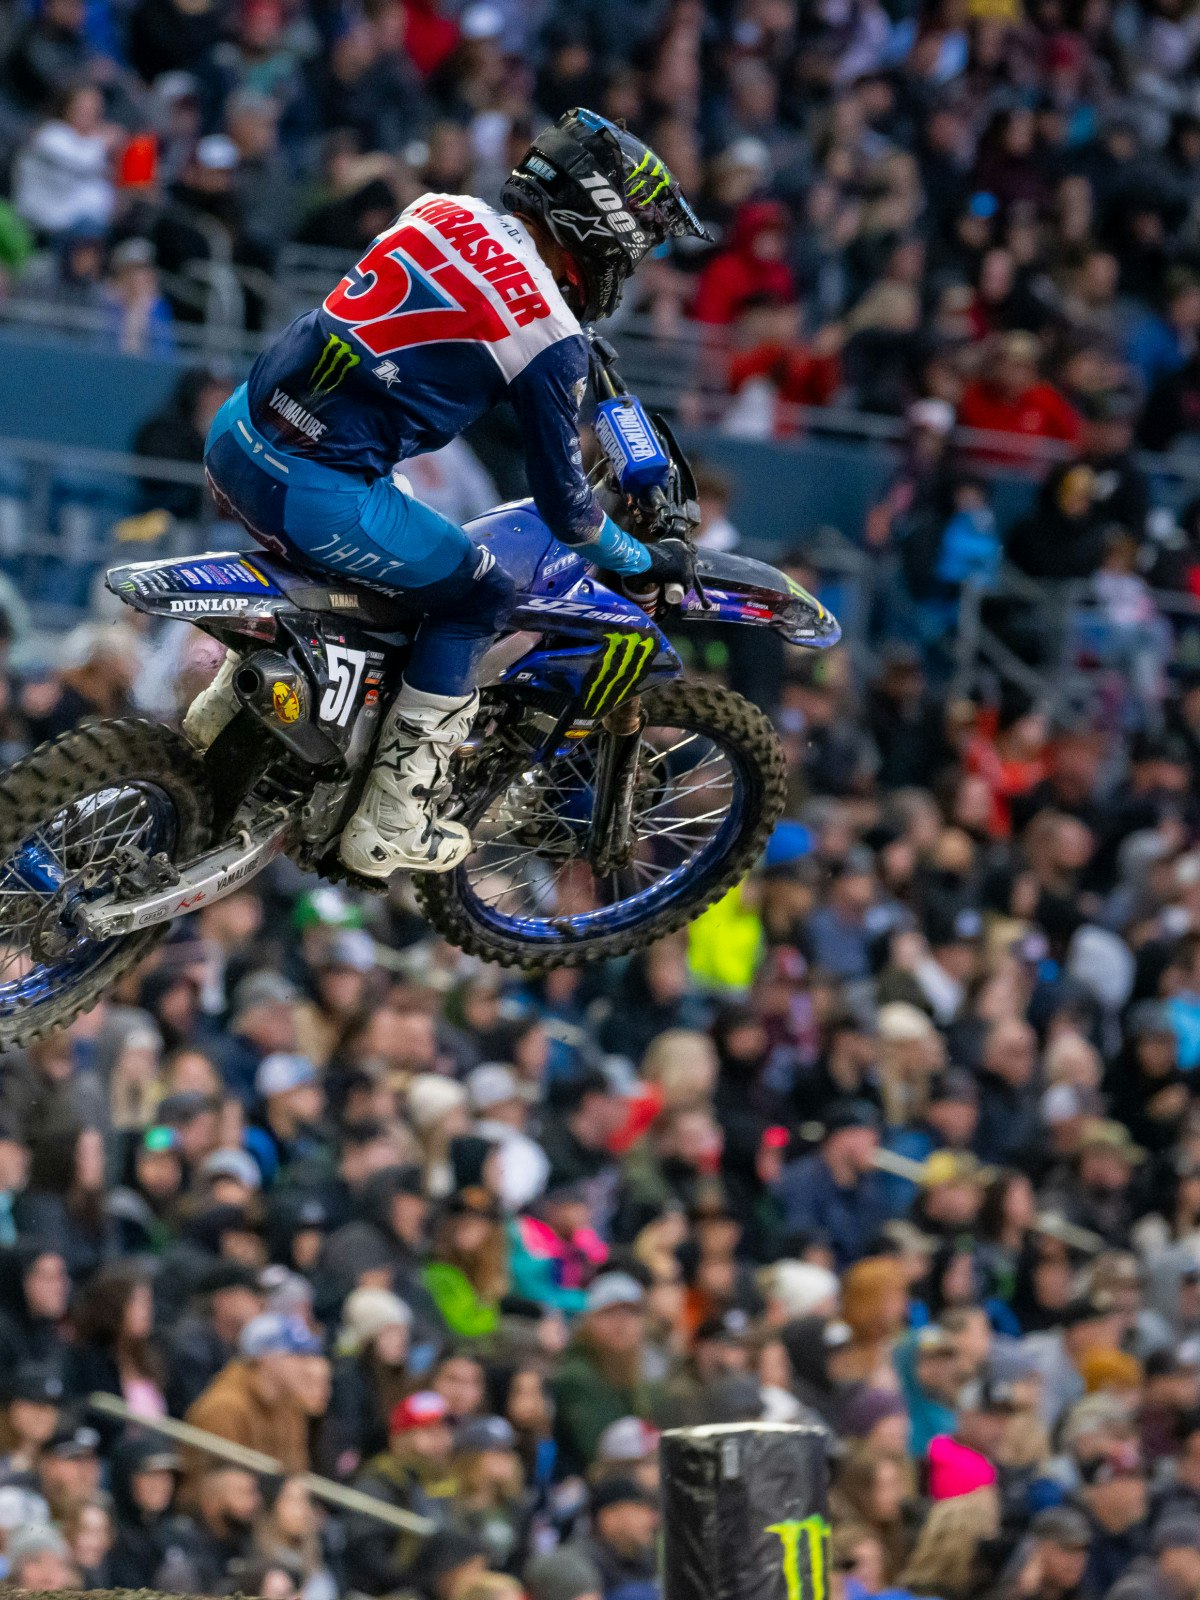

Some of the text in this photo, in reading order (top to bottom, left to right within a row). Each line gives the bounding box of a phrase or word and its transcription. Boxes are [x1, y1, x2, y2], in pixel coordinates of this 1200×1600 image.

[411, 199, 551, 328] THRASHER
[323, 224, 511, 358] 57
[268, 388, 327, 442] YAMALUBE
[170, 598, 249, 613] DUNLOP
[329, 594, 358, 608] YAMAHA
[695, 602, 720, 611] YAHA
[319, 644, 366, 728] 57
